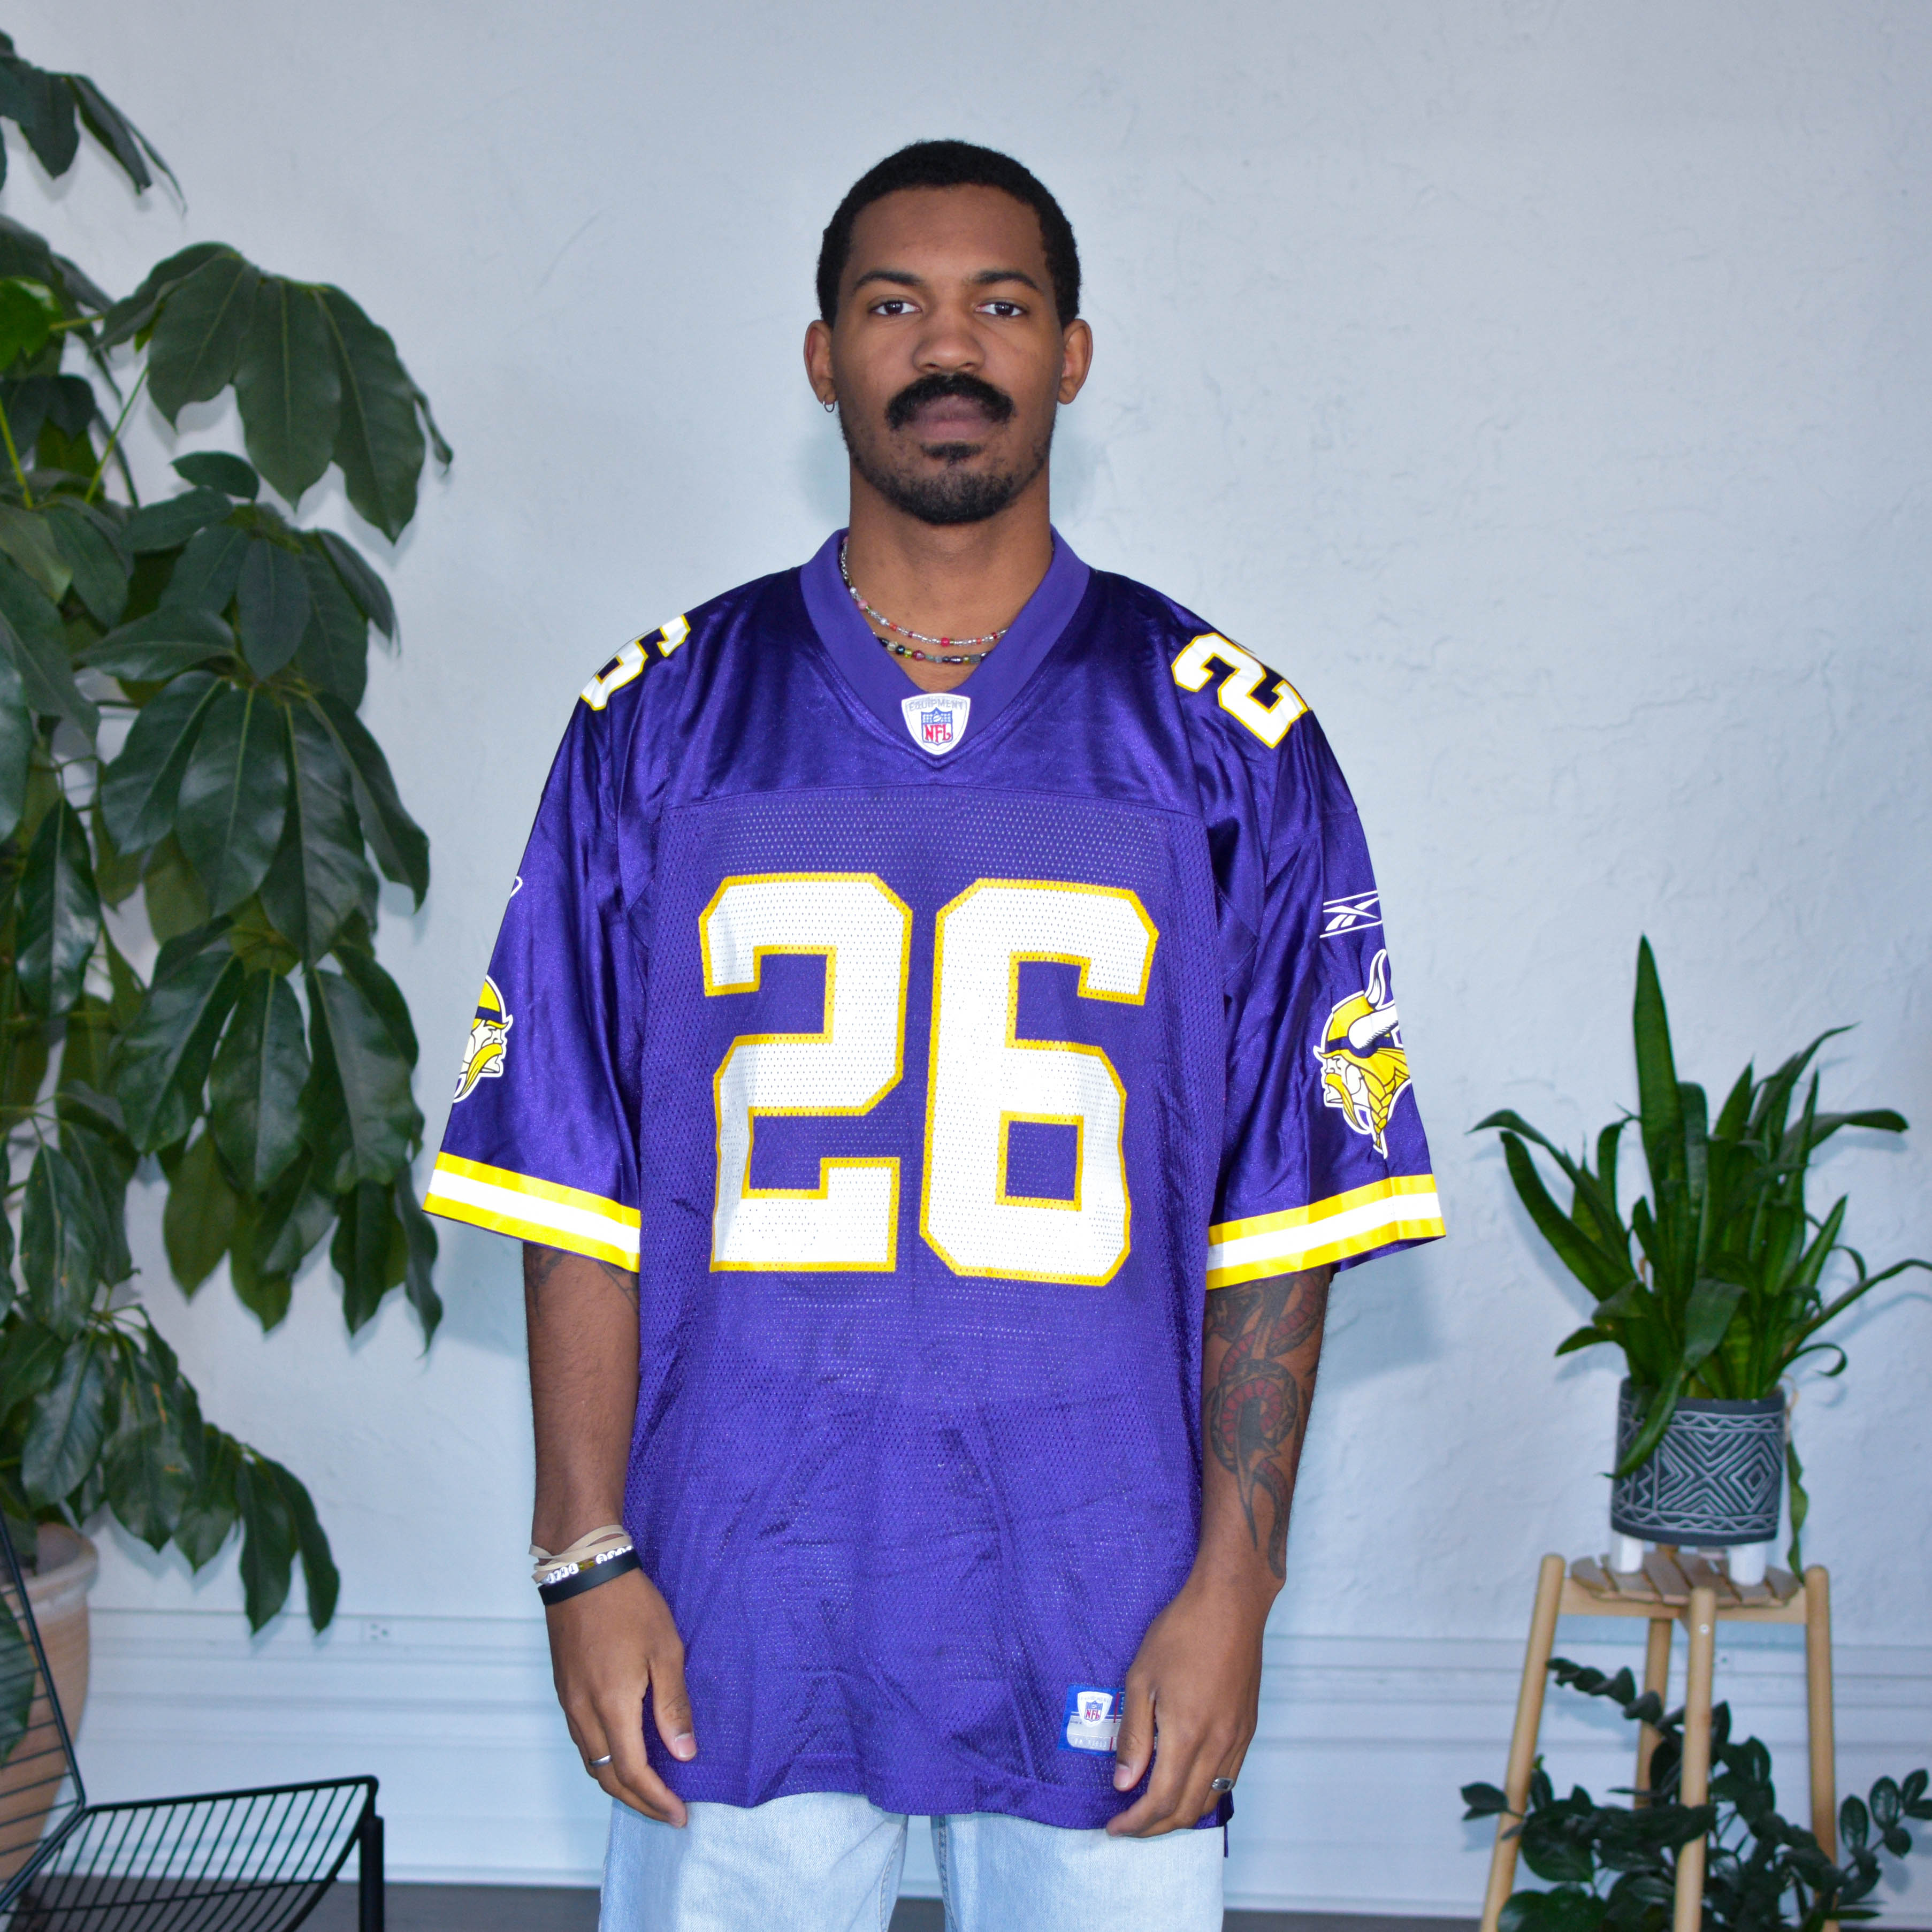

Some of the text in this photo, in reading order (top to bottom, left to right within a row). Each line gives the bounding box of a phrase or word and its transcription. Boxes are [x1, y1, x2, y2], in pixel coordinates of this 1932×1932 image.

[1171, 632, 1309, 749] 2
[909, 698, 964, 712] EQUIPMENT
[925, 723, 951, 743] NFL
[699, 872, 1159, 1287] 26
[1086, 1708, 1101, 1721] NFL
